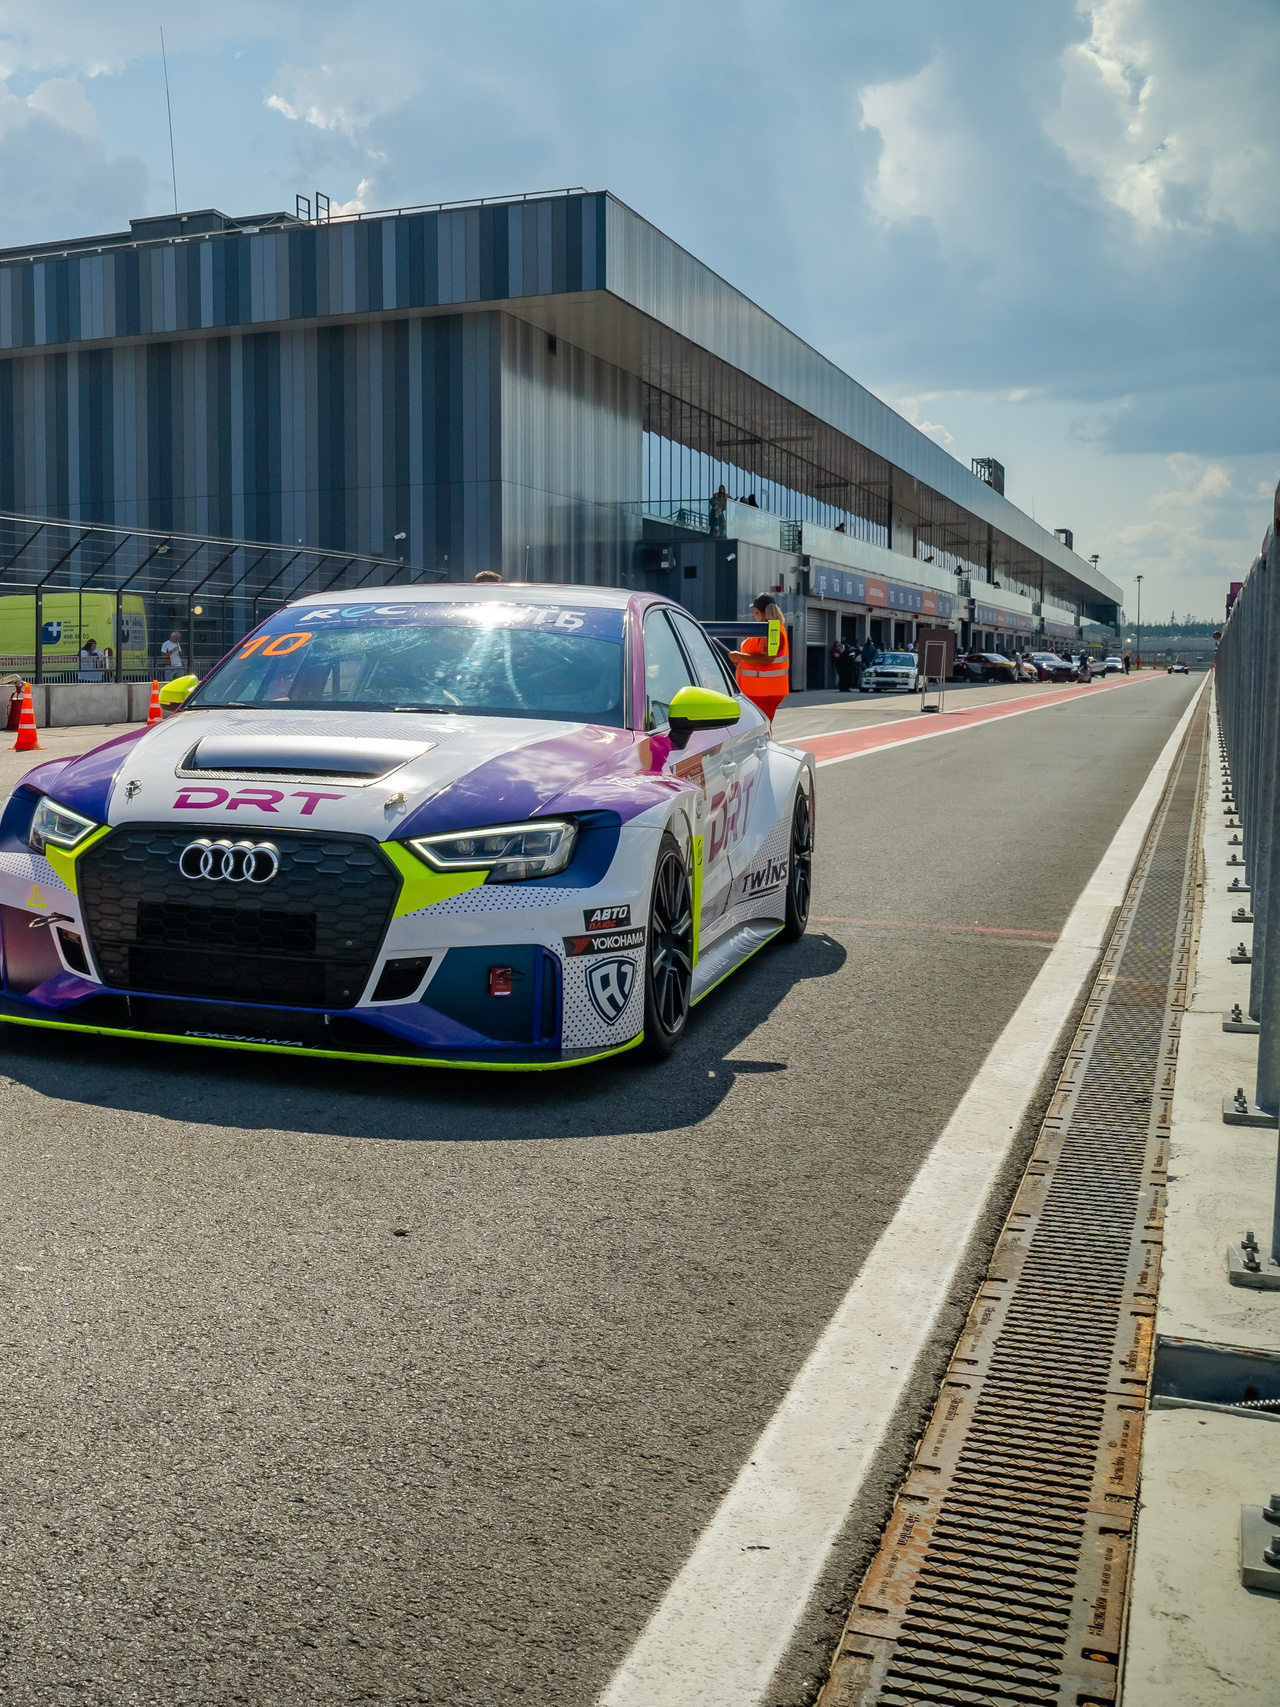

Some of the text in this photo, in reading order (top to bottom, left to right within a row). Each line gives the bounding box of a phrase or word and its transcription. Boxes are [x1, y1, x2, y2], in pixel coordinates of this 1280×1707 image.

[239, 631, 313, 660] 10
[172, 786, 347, 815] DRT
[708, 769, 755, 864] DRT
[742, 858, 788, 894] TWINS
[588, 919, 617, 930] ПЛЮС
[590, 906, 629, 922] АВТО
[591, 931, 644, 950] YOKOHAMA
[184, 1030, 304, 1047] YOKOHAMA
